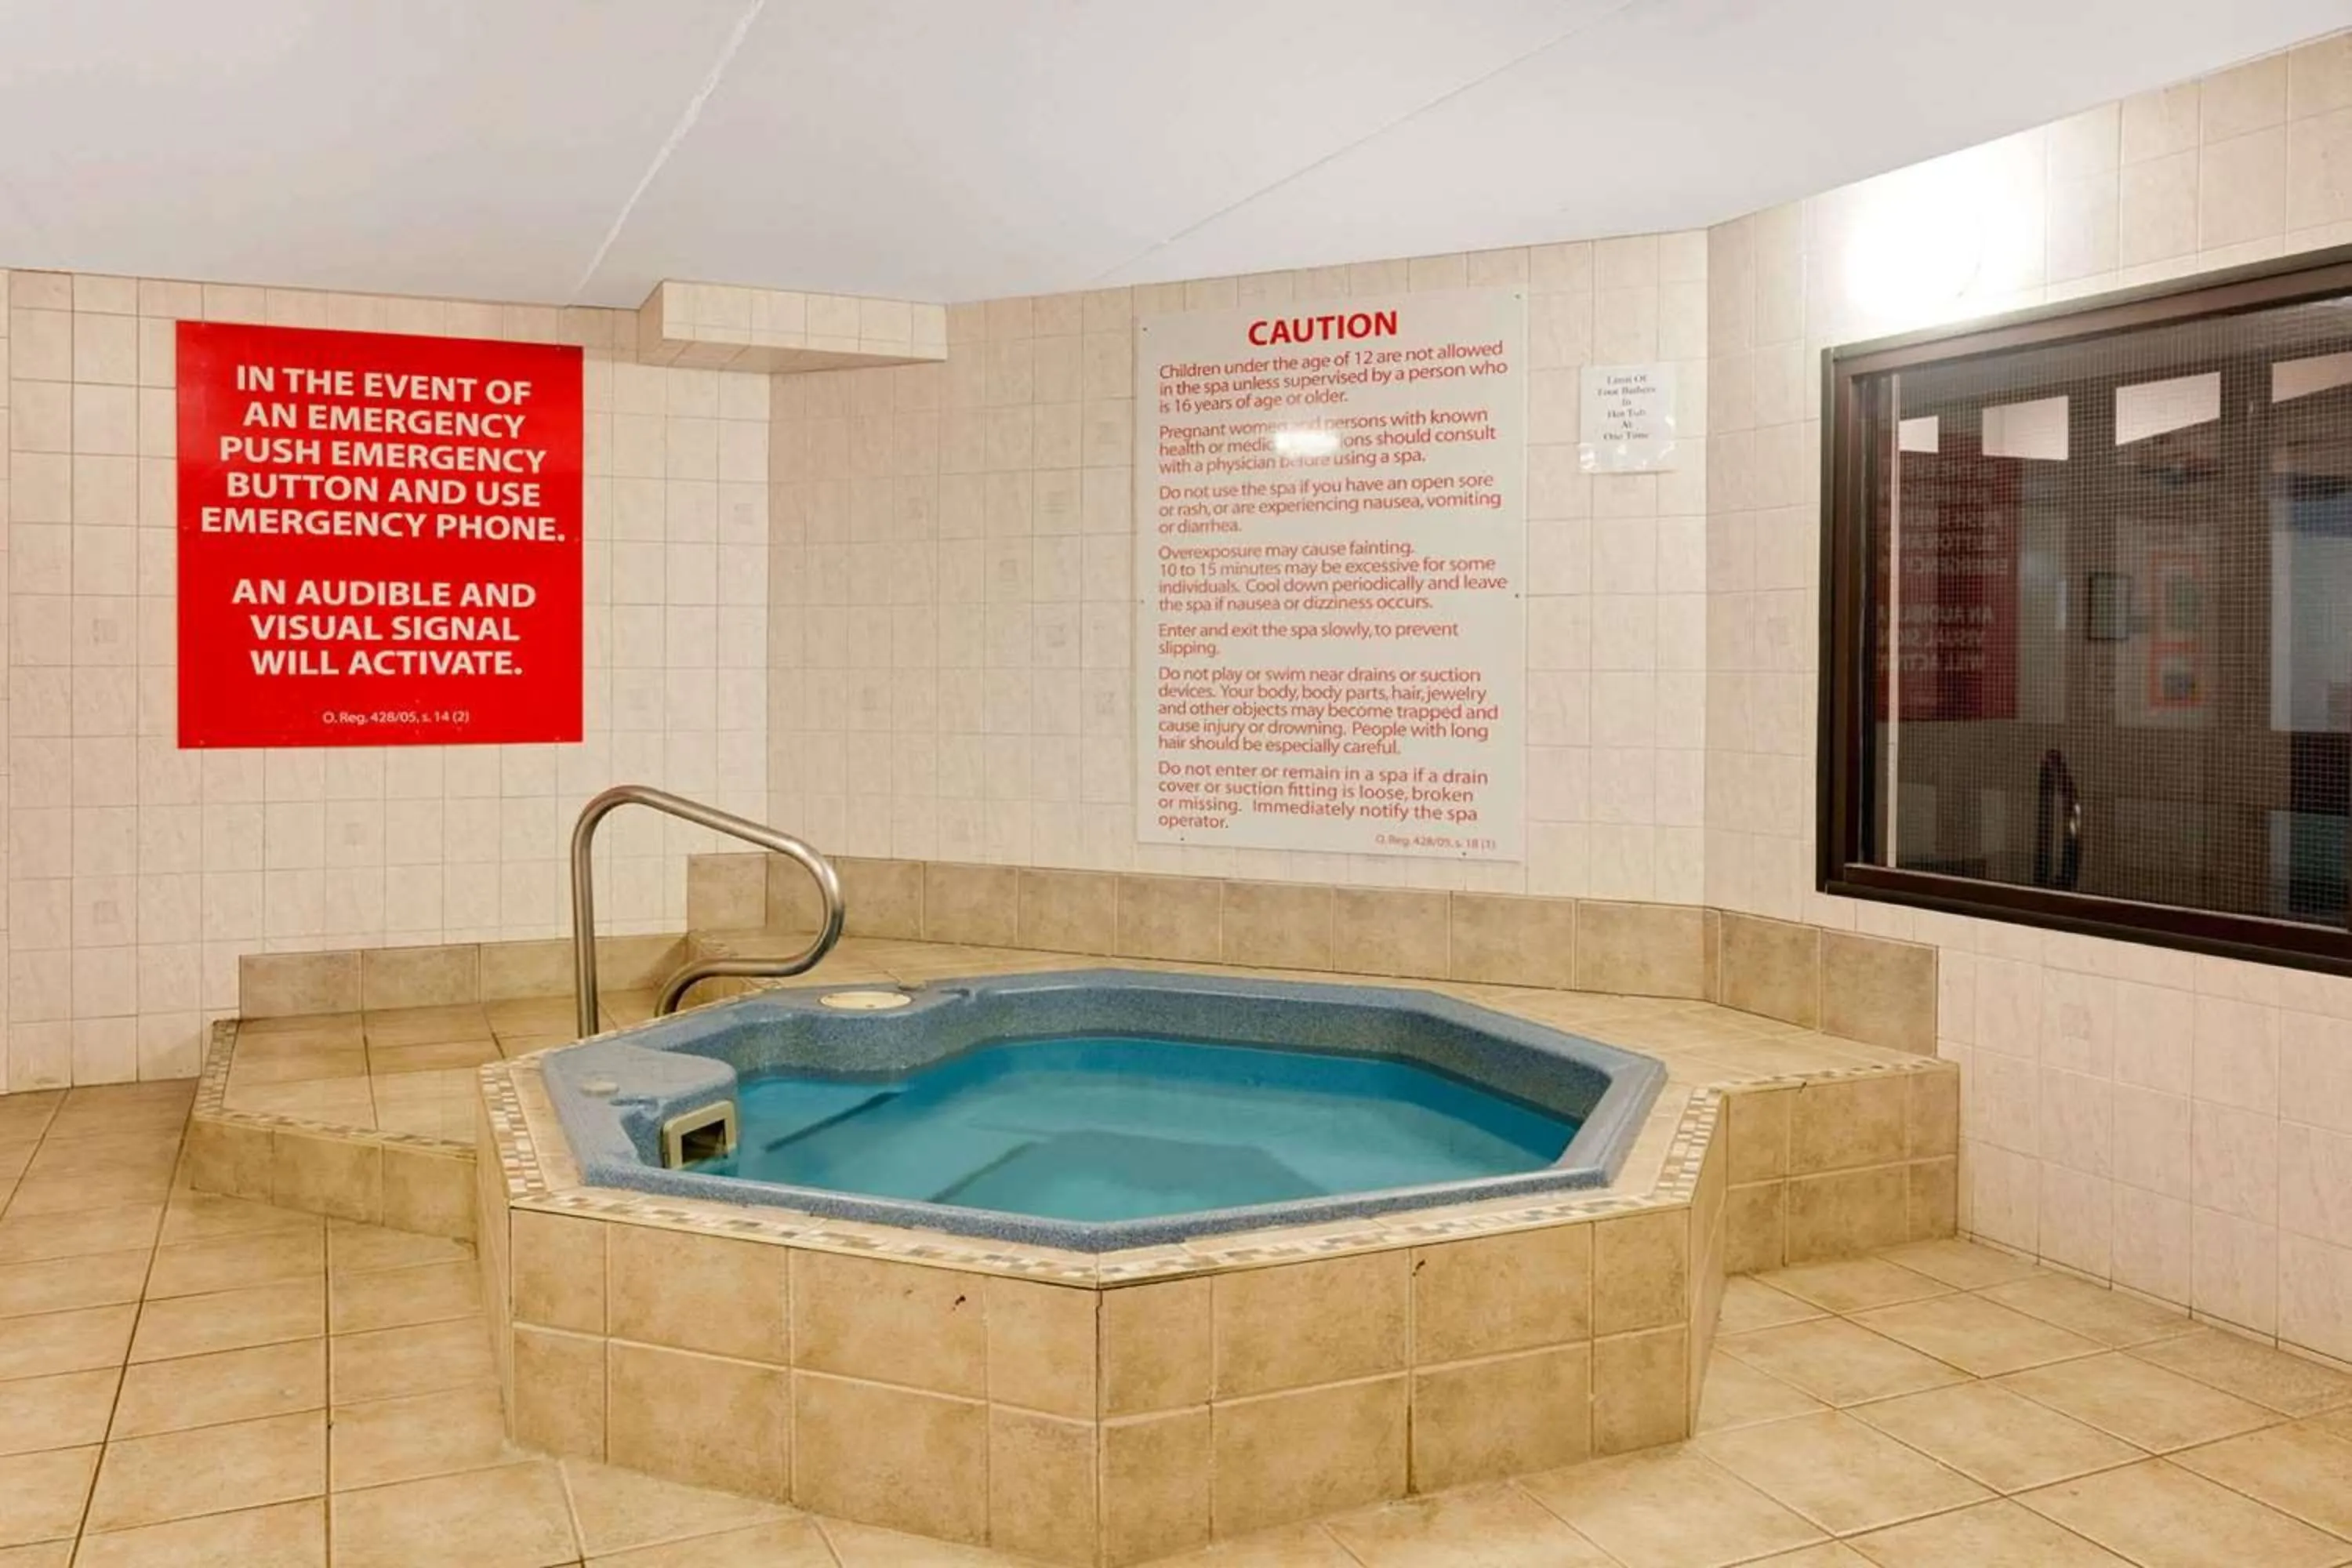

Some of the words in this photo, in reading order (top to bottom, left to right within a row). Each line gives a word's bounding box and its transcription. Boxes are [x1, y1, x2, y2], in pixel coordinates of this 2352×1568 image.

[1248, 310, 1399, 347] CAUTION
[1159, 363, 1221, 378] Children
[1223, 358, 1269, 373] under
[1272, 356, 1298, 370] the
[1301, 357, 1330, 371] age
[1333, 350, 1350, 365] of
[1355, 350, 1373, 364] 12
[1376, 350, 1402, 363] are
[1405, 347, 1434, 360] not
[1437, 340, 1503, 358] allowed
[238, 366, 275, 393] IN
[283, 369, 355, 397] THE
[365, 374, 477, 403] EVENT
[487, 381, 532, 406] OF
[1159, 382, 1173, 395] in
[1176, 381, 1200, 394] the
[1203, 381, 1229, 395] spa
[1232, 376, 1279, 390] unless
[1283, 368, 1368, 388] supervised
[1371, 368, 1392, 384] by
[1394, 369, 1405, 379] a
[1408, 365, 1465, 382] person
[1469, 361, 1508, 375] who
[1159, 399, 1171, 412] is
[1175, 398, 1192, 412] 16
[1194, 399, 1232, 413] years
[1235, 394, 1250, 408] of
[1254, 396, 1282, 410] age
[1285, 394, 1301, 405] or
[1304, 389, 1348, 404] older.
[245, 402, 298, 430] AN
[310, 404, 526, 440] EMERGENCY
[221, 436, 321, 466] PUSH
[333, 442, 547, 474] EMERGENCY
[228, 473, 379, 503] BUTTON
[390, 479, 468, 505] AND
[477, 482, 541, 508] USE
[1158, 505, 1174, 517] or
[1177, 502, 1211, 517] rash,
[1213, 503, 1228, 514] or
[1232, 503, 1254, 514] are
[1258, 499, 1359, 515] experiencing
[1363, 497, 1425, 510] nausea,
[1427, 493, 1501, 508] vomiting
[203, 508, 428, 538] EMERGENCY
[438, 515, 566, 543] PHONE.
[1157, 523, 1174, 534] or
[1177, 519, 1242, 532] diarrhea.
[1157, 546, 1261, 560] Overexposure
[1265, 545, 1298, 559] may
[1301, 544, 1346, 556] cause
[1348, 539, 1414, 557] fainting.
[1160, 563, 1176, 576] 10
[1179, 564, 1195, 575] to
[1200, 561, 1216, 575] 15
[1220, 562, 1280, 575] minutes
[1284, 563, 1317, 576] may
[1321, 559, 1341, 573] be
[1345, 557, 1420, 572] excessive
[1422, 557, 1446, 571] for
[1449, 559, 1496, 571] some
[234, 580, 287, 605] AN
[296, 581, 452, 608] AUDIBLE
[461, 584, 537, 608] AND
[1245, 578, 1279, 592] Cool
[1283, 579, 1327, 592] down
[1332, 575, 1423, 593] periodically
[1428, 575, 1459, 590] and
[1463, 575, 1508, 589] leave
[1158, 597, 1182, 611] the
[1185, 601, 1212, 613] spa
[1214, 596, 1223, 610] if
[1226, 599, 1280, 610] nausea
[1283, 599, 1299, 610] or
[1302, 596, 1374, 609] dizziness
[1375, 597, 1433, 608] occurs.
[252, 615, 384, 641] VISUAL
[393, 617, 521, 642] SIGNAL
[1158, 622, 1197, 637] Enter
[1200, 622, 1229, 637] and
[1229, 624, 1260, 637] exit
[1260, 622, 1288, 637] the
[1290, 625, 1318, 639] spa
[1319, 622, 1373, 640] slowly,
[1374, 624, 1392, 637] to
[1395, 623, 1458, 638] prevent
[1158, 641, 1221, 657] slipping.
[252, 652, 340, 676] WILL
[348, 652, 524, 677] ACTIVATE.
[1158, 666, 1180, 679] Do
[1183, 668, 1209, 680] not
[1211, 666, 1243, 683] play
[1245, 670, 1261, 680] or
[1265, 667, 1305, 680] swim
[1309, 670, 1345, 681] near
[1347, 667, 1396, 681] drains
[1399, 670, 1418, 681] or
[1419, 668, 1481, 681] suction
[1221, 683, 1254, 698] Your
[1257, 684, 1299, 702] body,
[1301, 684, 1341, 702] body
[1345, 688, 1388, 702] parts,
[322, 710, 339, 725] O.
[339, 711, 369, 727] Reg.
[370, 711, 421, 725] 428/05,
[434, 710, 451, 724] 14
[452, 710, 471, 724] (2)
[1157, 702, 1185, 713] and
[1189, 702, 1229, 714] other
[1232, 702, 1287, 717] objects
[1290, 706, 1324, 719] may
[1327, 702, 1392, 717] become
[1396, 705, 1461, 720] trapped
[1465, 705, 1499, 719] and
[1158, 720, 1199, 731] cause
[1203, 722, 1245, 735] injury
[1247, 722, 1264, 733] or
[1267, 720, 1346, 738] drowning.
[1352, 720, 1406, 739] People
[1410, 722, 1446, 737] with
[1450, 724, 1488, 741] long
[1158, 781, 1199, 792] cover
[1203, 782, 1221, 793] or
[1225, 782, 1283, 794] suction
[1287, 782, 1337, 800] fitting
[1342, 784, 1355, 797] is
[1359, 785, 1408, 801] loose,
[1411, 786, 1473, 801] broken
[1157, 797, 1174, 808] or
[1178, 797, 1242, 815] missing.
[1252, 801, 1355, 818] Immediately
[1359, 804, 1409, 821] notify
[1414, 805, 1443, 819] the
[1447, 809, 1477, 823] spa
[1158, 815, 1229, 828] operator.
